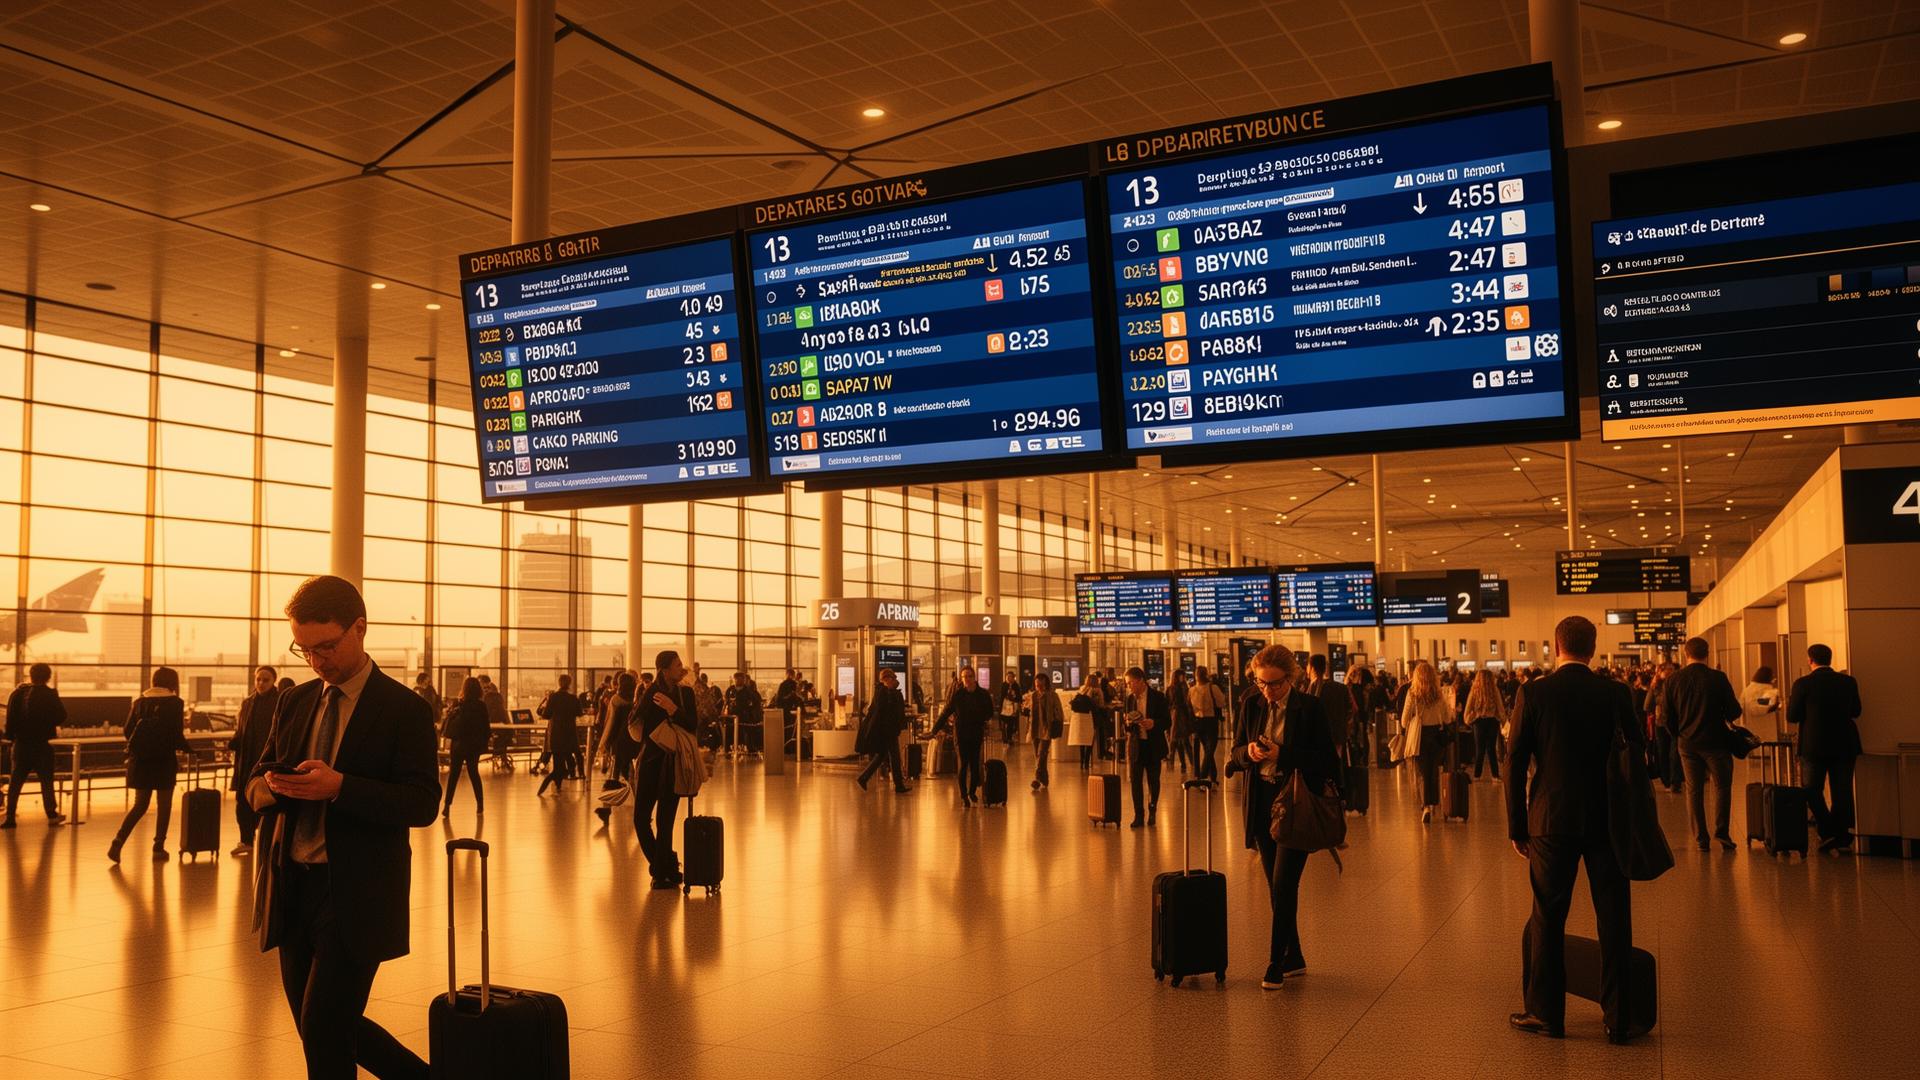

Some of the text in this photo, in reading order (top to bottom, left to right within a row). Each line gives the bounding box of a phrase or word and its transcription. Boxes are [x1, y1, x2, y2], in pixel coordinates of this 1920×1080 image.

[1126, 176, 1160, 207] 13
[755, 192, 847, 224] DEPATARES
[1448, 215, 1496, 240] 4:47
[764, 235, 791, 263] 13
[1449, 246, 1496, 272] 2:47
[475, 283, 499, 309] 13
[1450, 278, 1499, 304] 3:44
[1451, 309, 1500, 335] 2:35
[1132, 401, 1166, 422] 129
[571, 429, 619, 446] PARKING
[1892, 480, 1920, 524] 4
[1457, 592, 1472, 615] 2
[982, 616, 992, 631] 2
